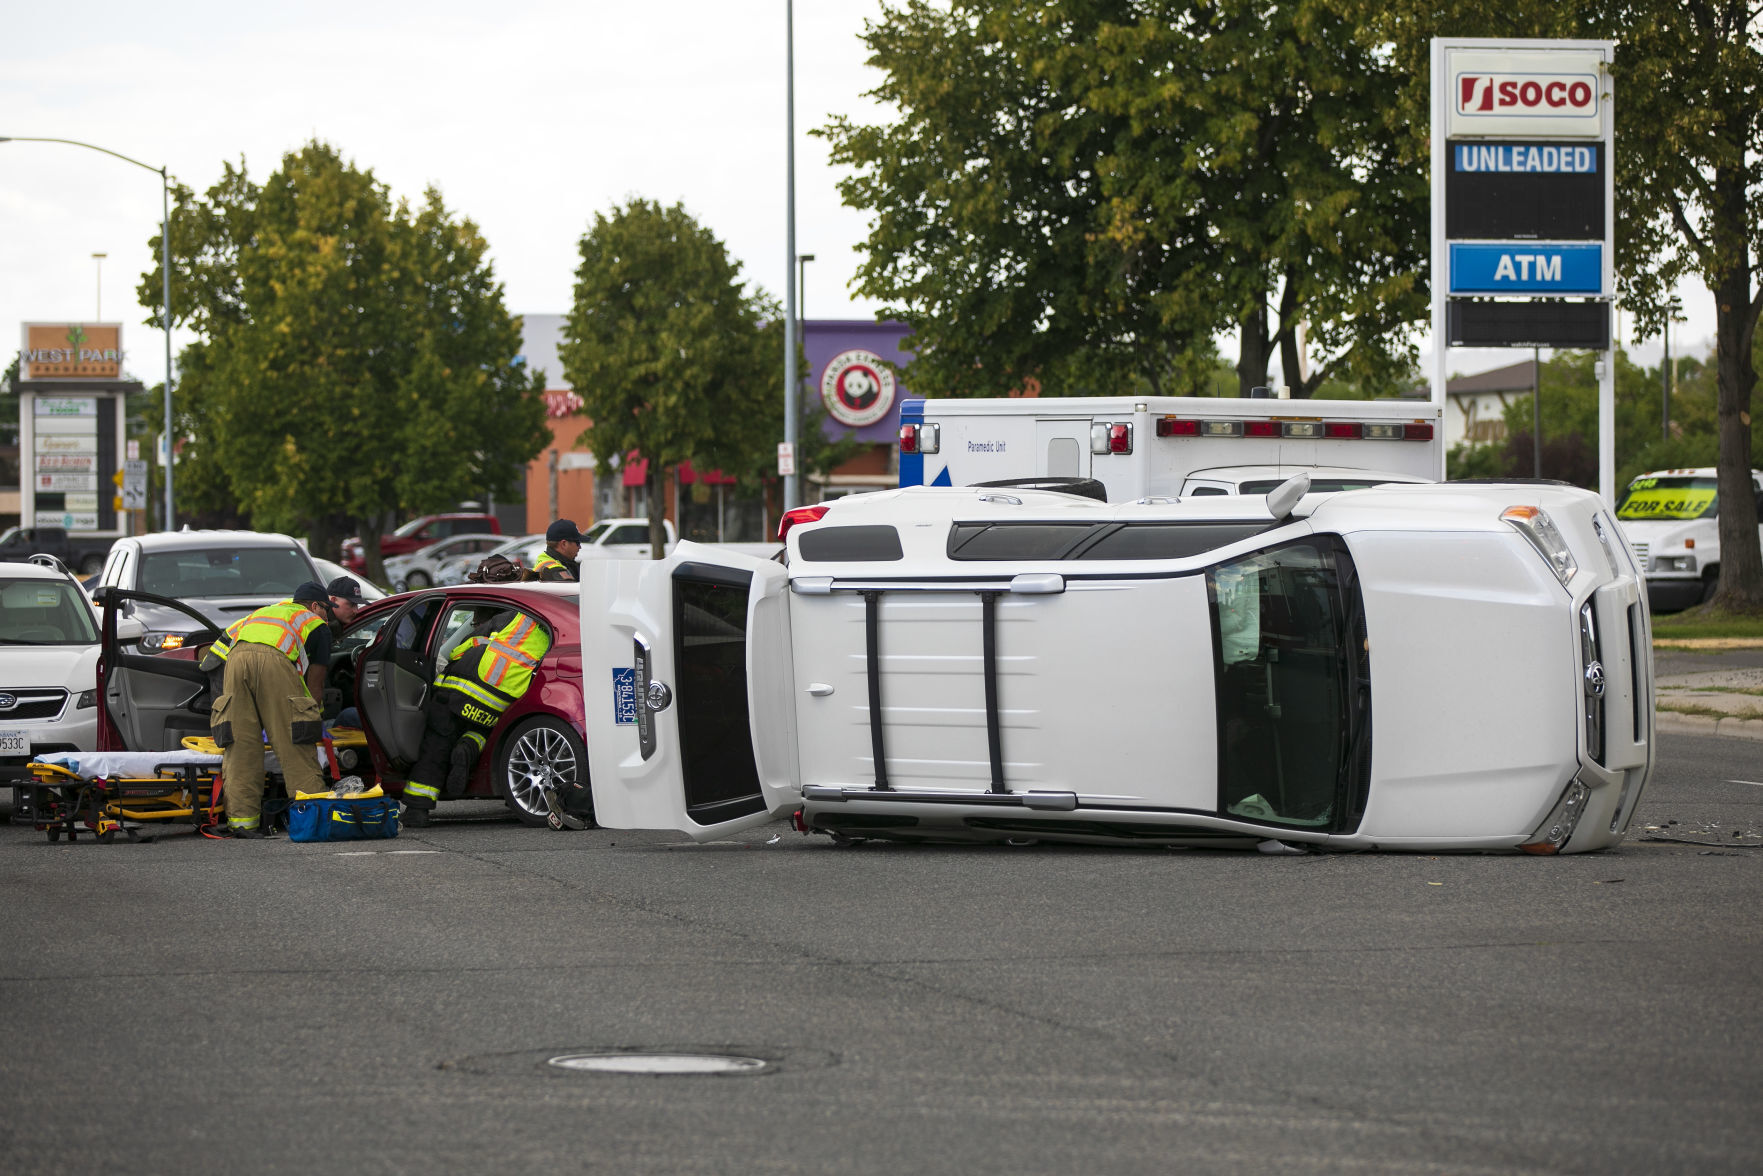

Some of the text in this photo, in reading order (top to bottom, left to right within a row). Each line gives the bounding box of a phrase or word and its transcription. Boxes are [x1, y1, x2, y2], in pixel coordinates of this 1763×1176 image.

[1498, 80, 1592, 108] SOCO
[1462, 146, 1590, 172] UNLEADED
[1493, 254, 1562, 281] ATM
[19, 347, 74, 363] WEST
[967, 440, 1006, 453] Paramedic Unit
[1623, 500, 1708, 513] FOR SALE
[0, 737, 24, 750] 533C
